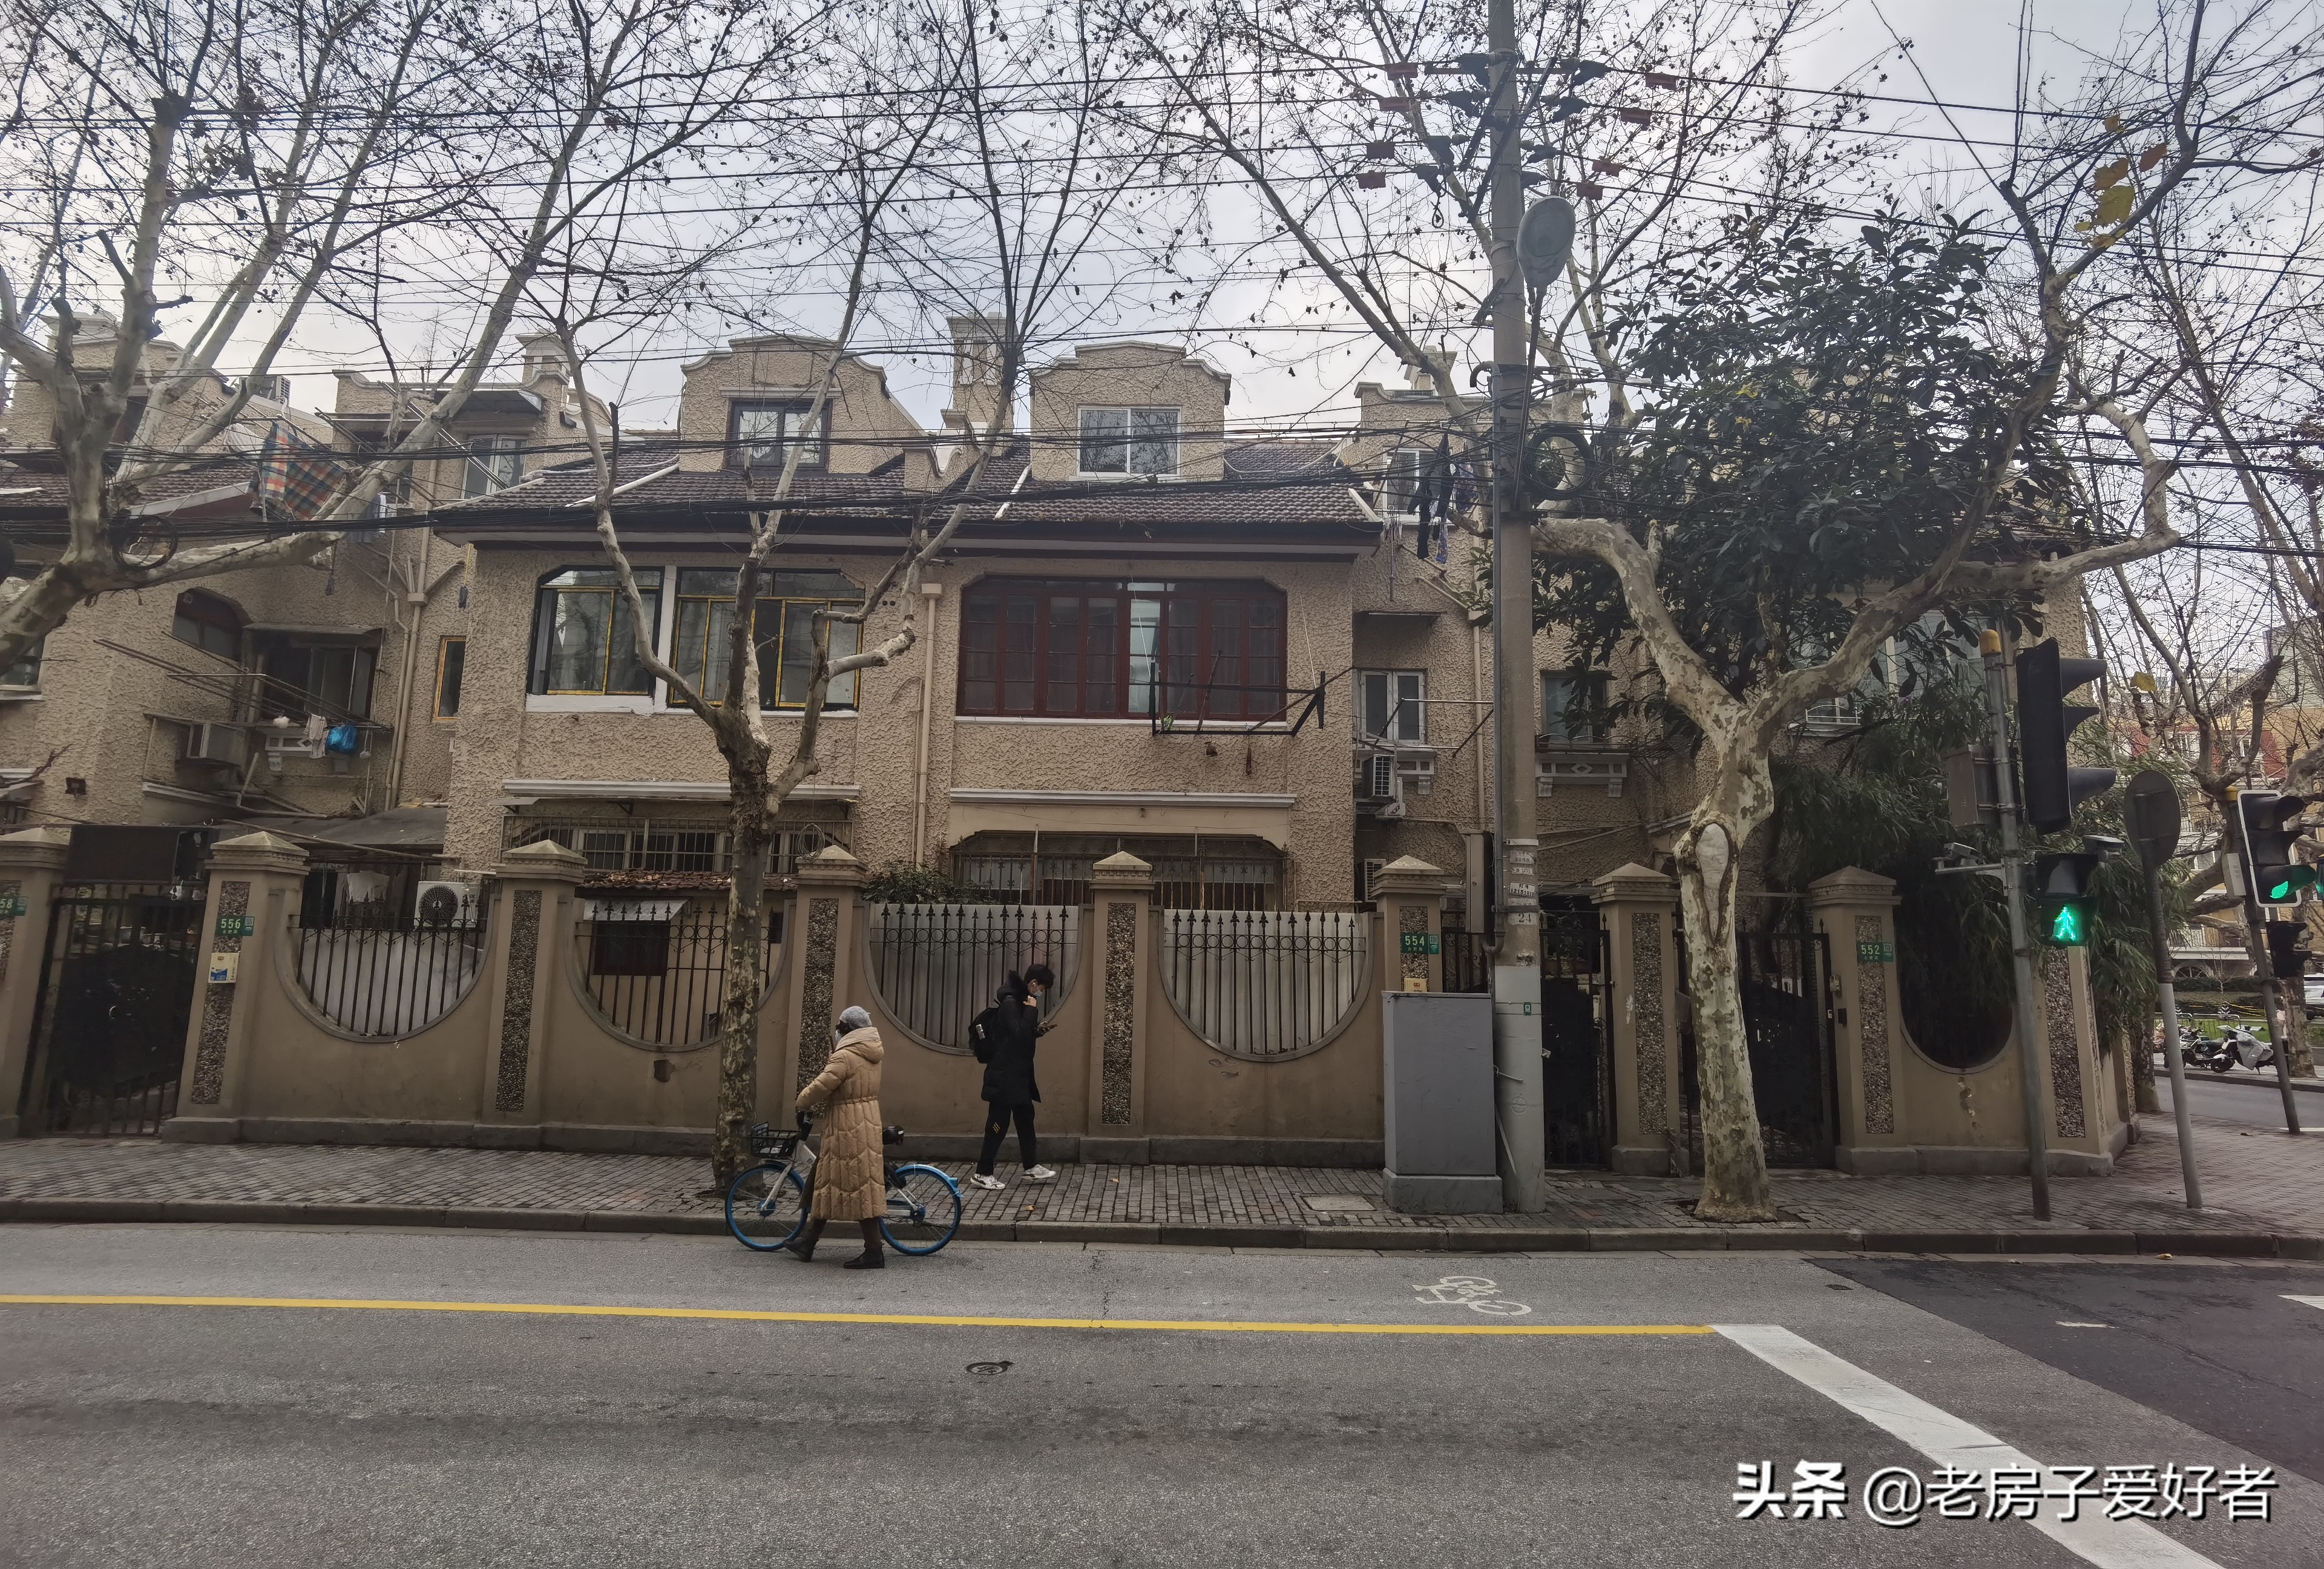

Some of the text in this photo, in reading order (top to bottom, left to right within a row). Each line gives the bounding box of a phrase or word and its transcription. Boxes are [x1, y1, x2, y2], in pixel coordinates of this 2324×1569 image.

[1518, 912, 1532, 923] 24
[221, 918, 241, 929] 556
[1405, 935, 1425, 946] 554
[1860, 944, 1880, 955] 552
